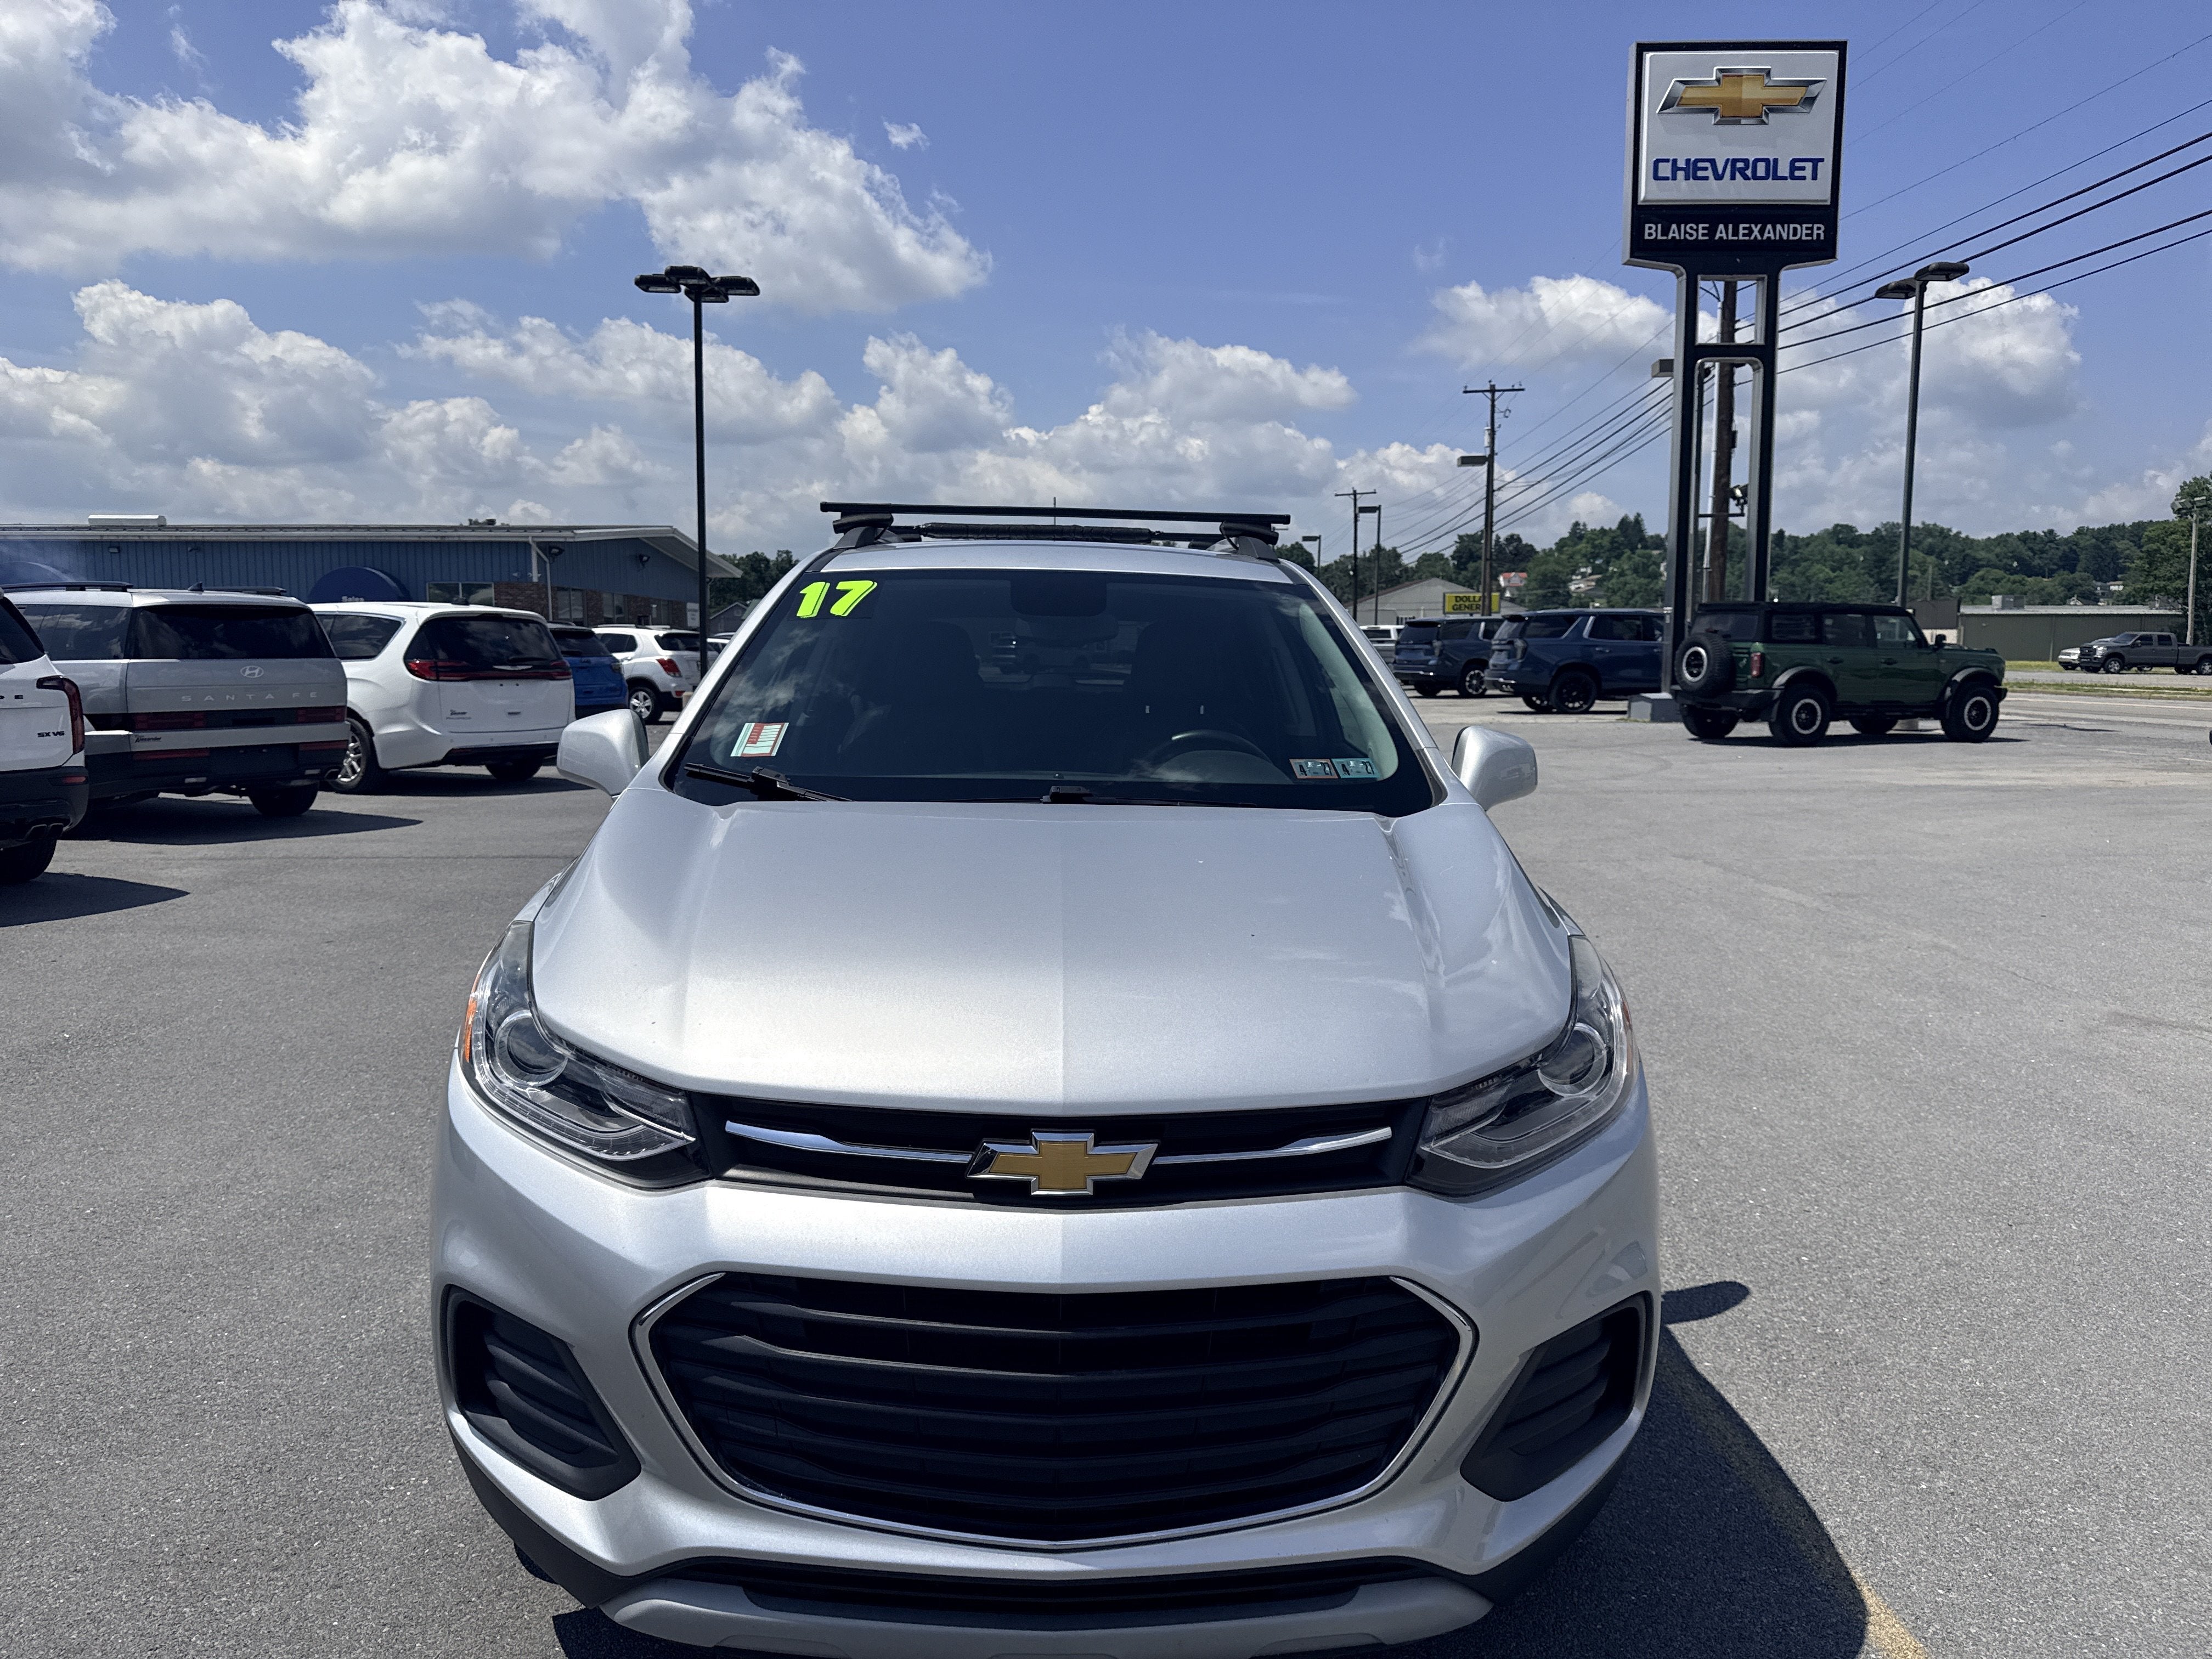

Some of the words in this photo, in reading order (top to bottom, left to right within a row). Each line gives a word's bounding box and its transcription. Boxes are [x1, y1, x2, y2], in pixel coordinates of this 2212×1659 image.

[1652, 157, 1825, 181] CHEVROLET
[1644, 223, 1709, 240] BLAISE
[1714, 223, 1825, 240] ALEXANDER
[797, 580, 878, 618] 17
[182, 693, 275, 702] SANTA
[1299, 764, 1308, 776] 4
[1341, 764, 1351, 776] 4
